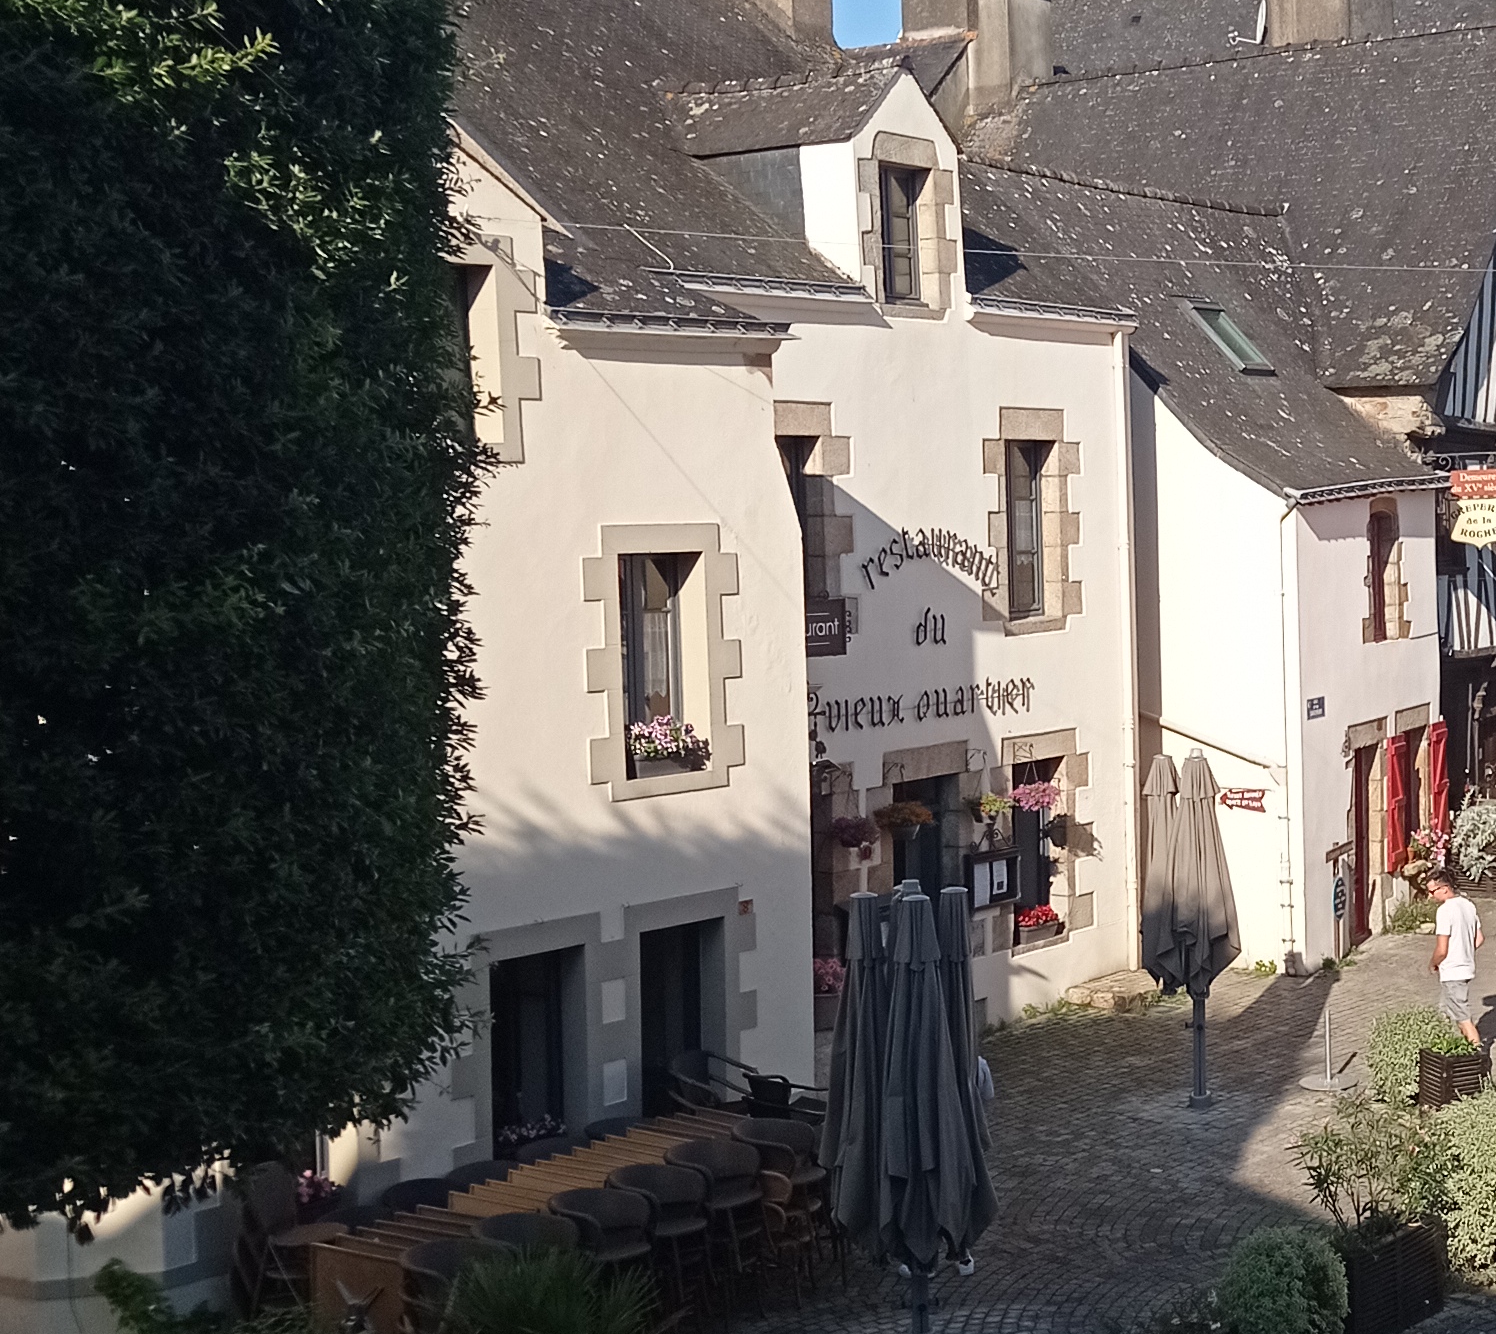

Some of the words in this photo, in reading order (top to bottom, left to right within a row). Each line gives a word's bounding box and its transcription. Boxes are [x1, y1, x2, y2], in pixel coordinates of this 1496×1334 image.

[1459, 472, 1496, 481] Demeure
[1450, 485, 1462, 493] du
[1482, 516, 1492, 524] la
[861, 527, 999, 597] restaurant
[915, 606, 947, 646] du
[826, 693, 904, 733] vieux
